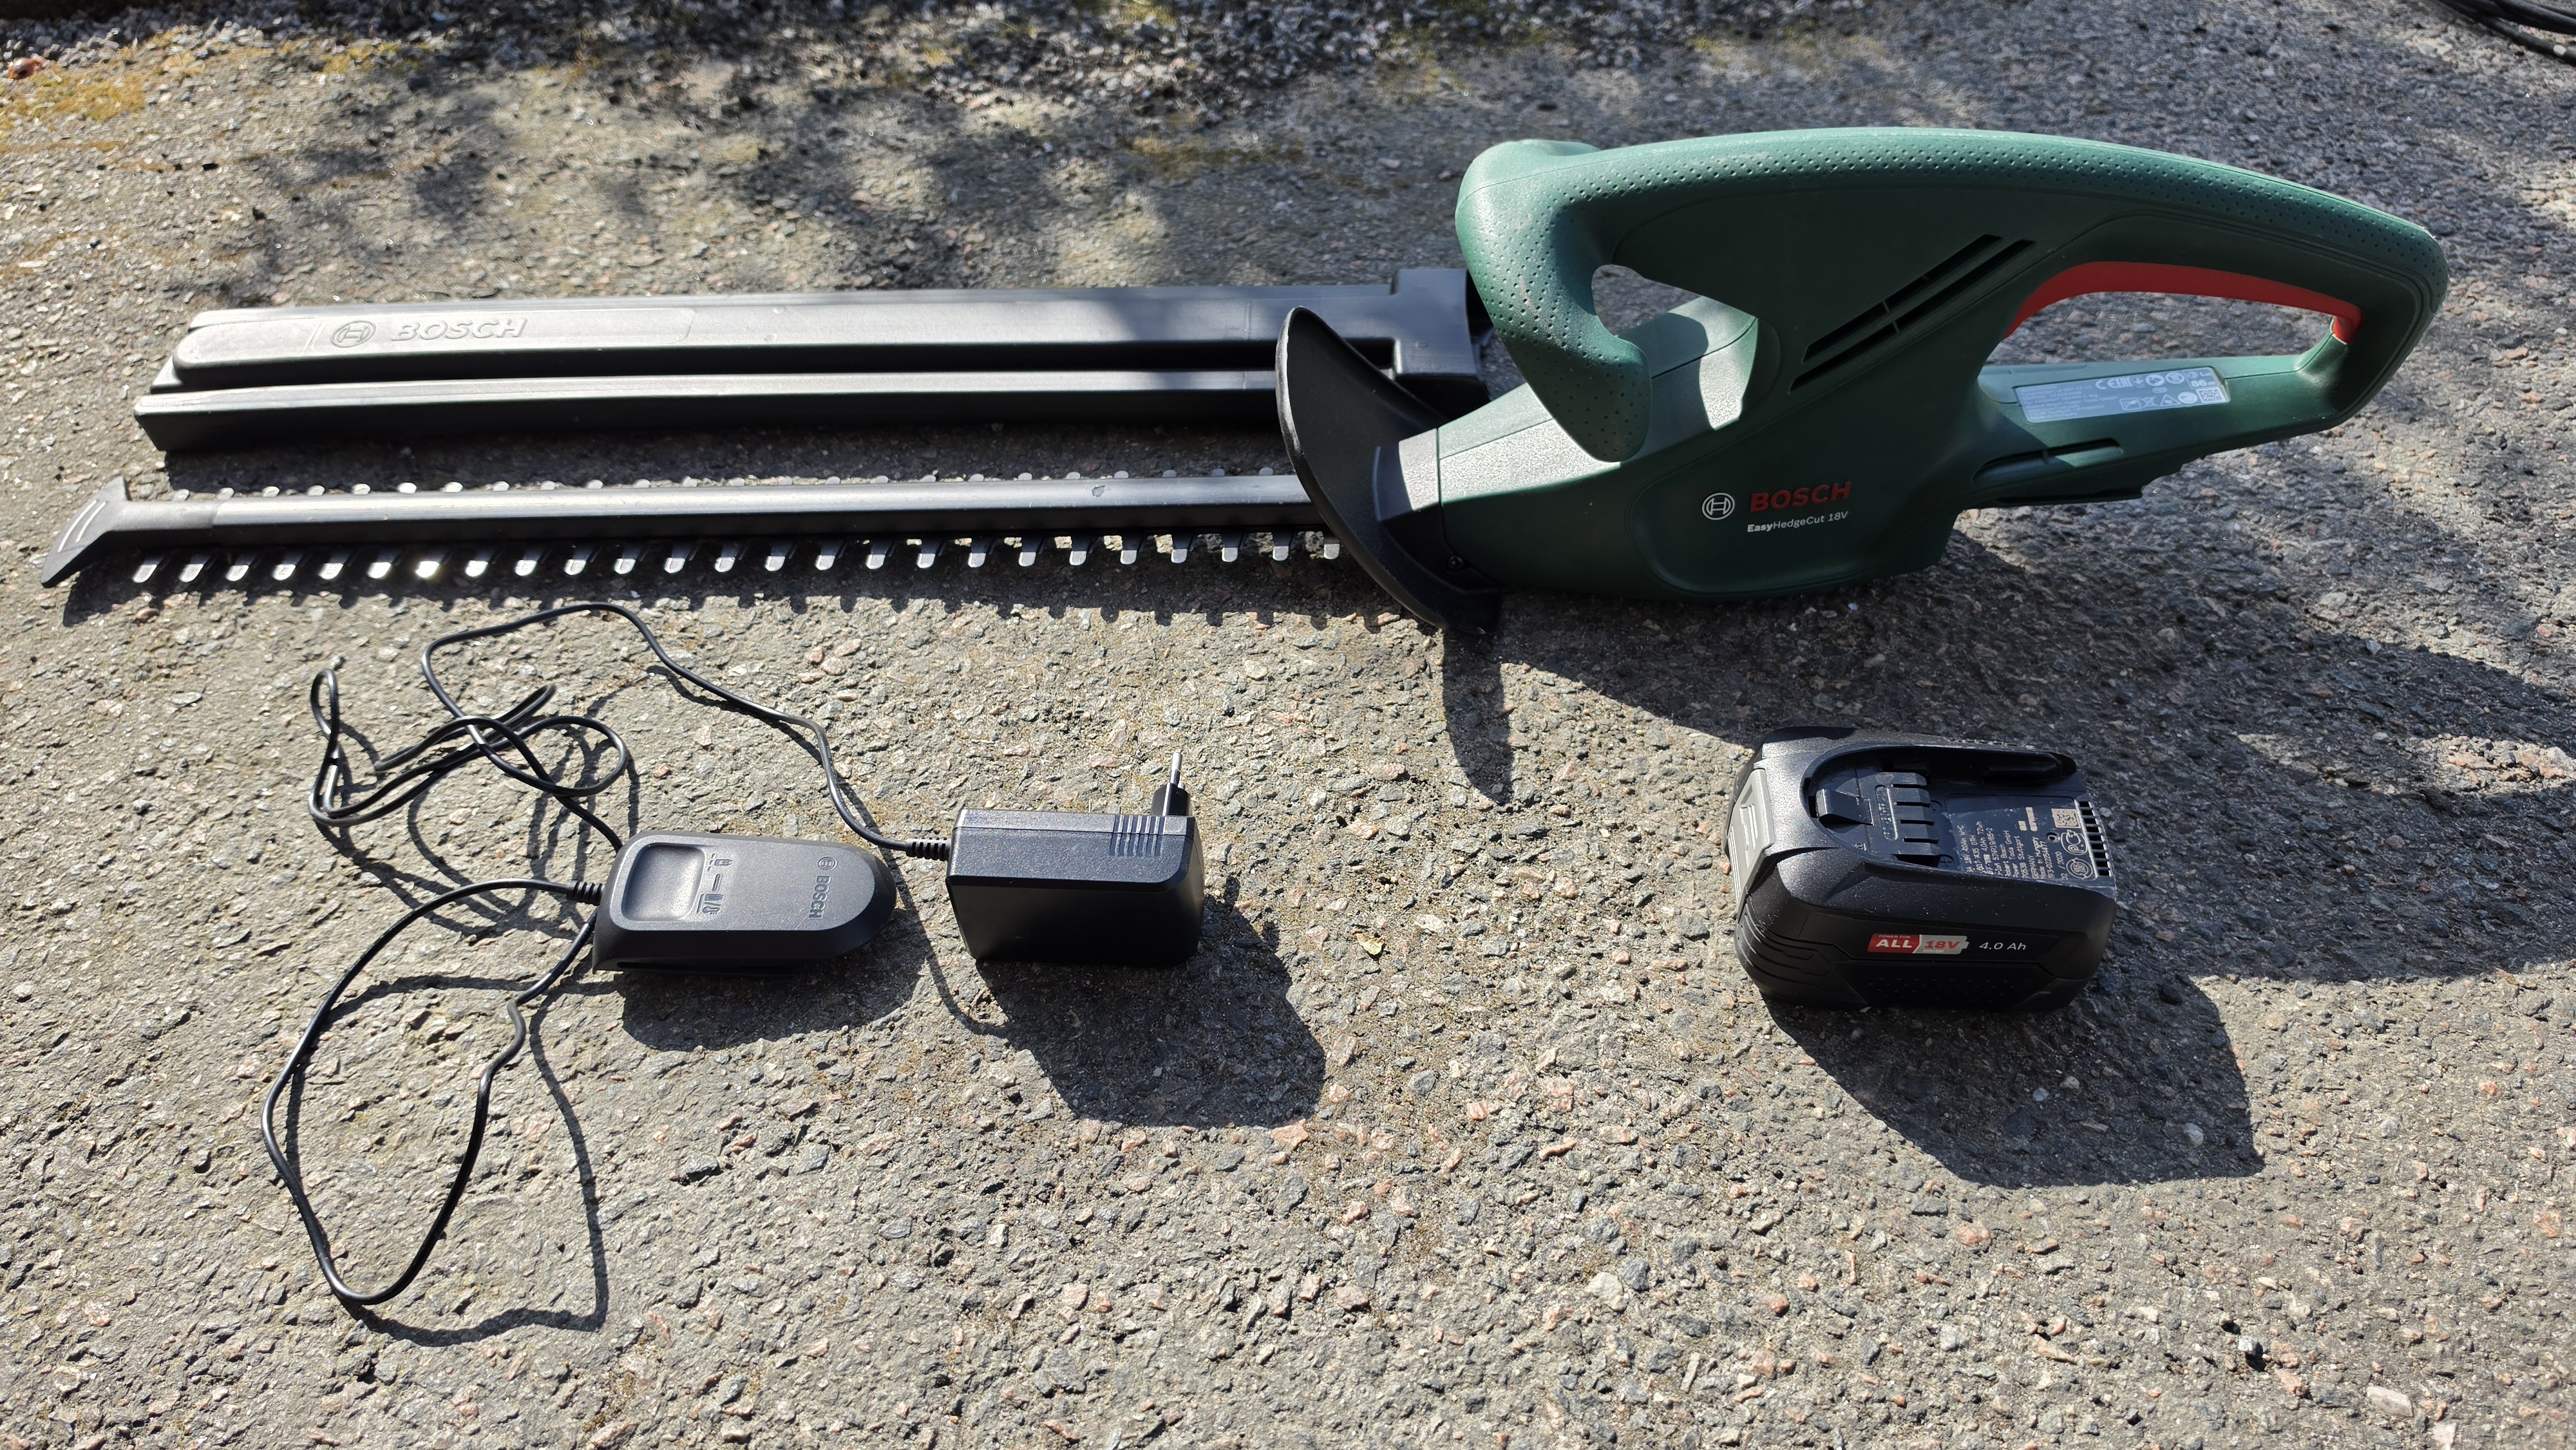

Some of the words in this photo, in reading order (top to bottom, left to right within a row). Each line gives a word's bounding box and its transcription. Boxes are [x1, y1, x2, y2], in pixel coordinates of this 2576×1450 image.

[391, 318, 528, 342] BOSCH
[2190, 379, 2207, 388] 86
[1750, 481, 1852, 513] BOSCH
[1747, 515, 1824, 532] EasyHedgeCut
[1828, 511, 1850, 522] 18V
[2014, 836, 2026, 860] Stuttgart
[2032, 837, 2042, 857] Hungary
[2011, 863, 2020, 877] Power
[2028, 855, 2038, 878] GERMANY
[808, 875, 831, 919] BOSCH
[1875, 939, 1912, 948] ALL
[1924, 941, 1960, 950] 18V
[2007, 942, 2027, 950] Ah
